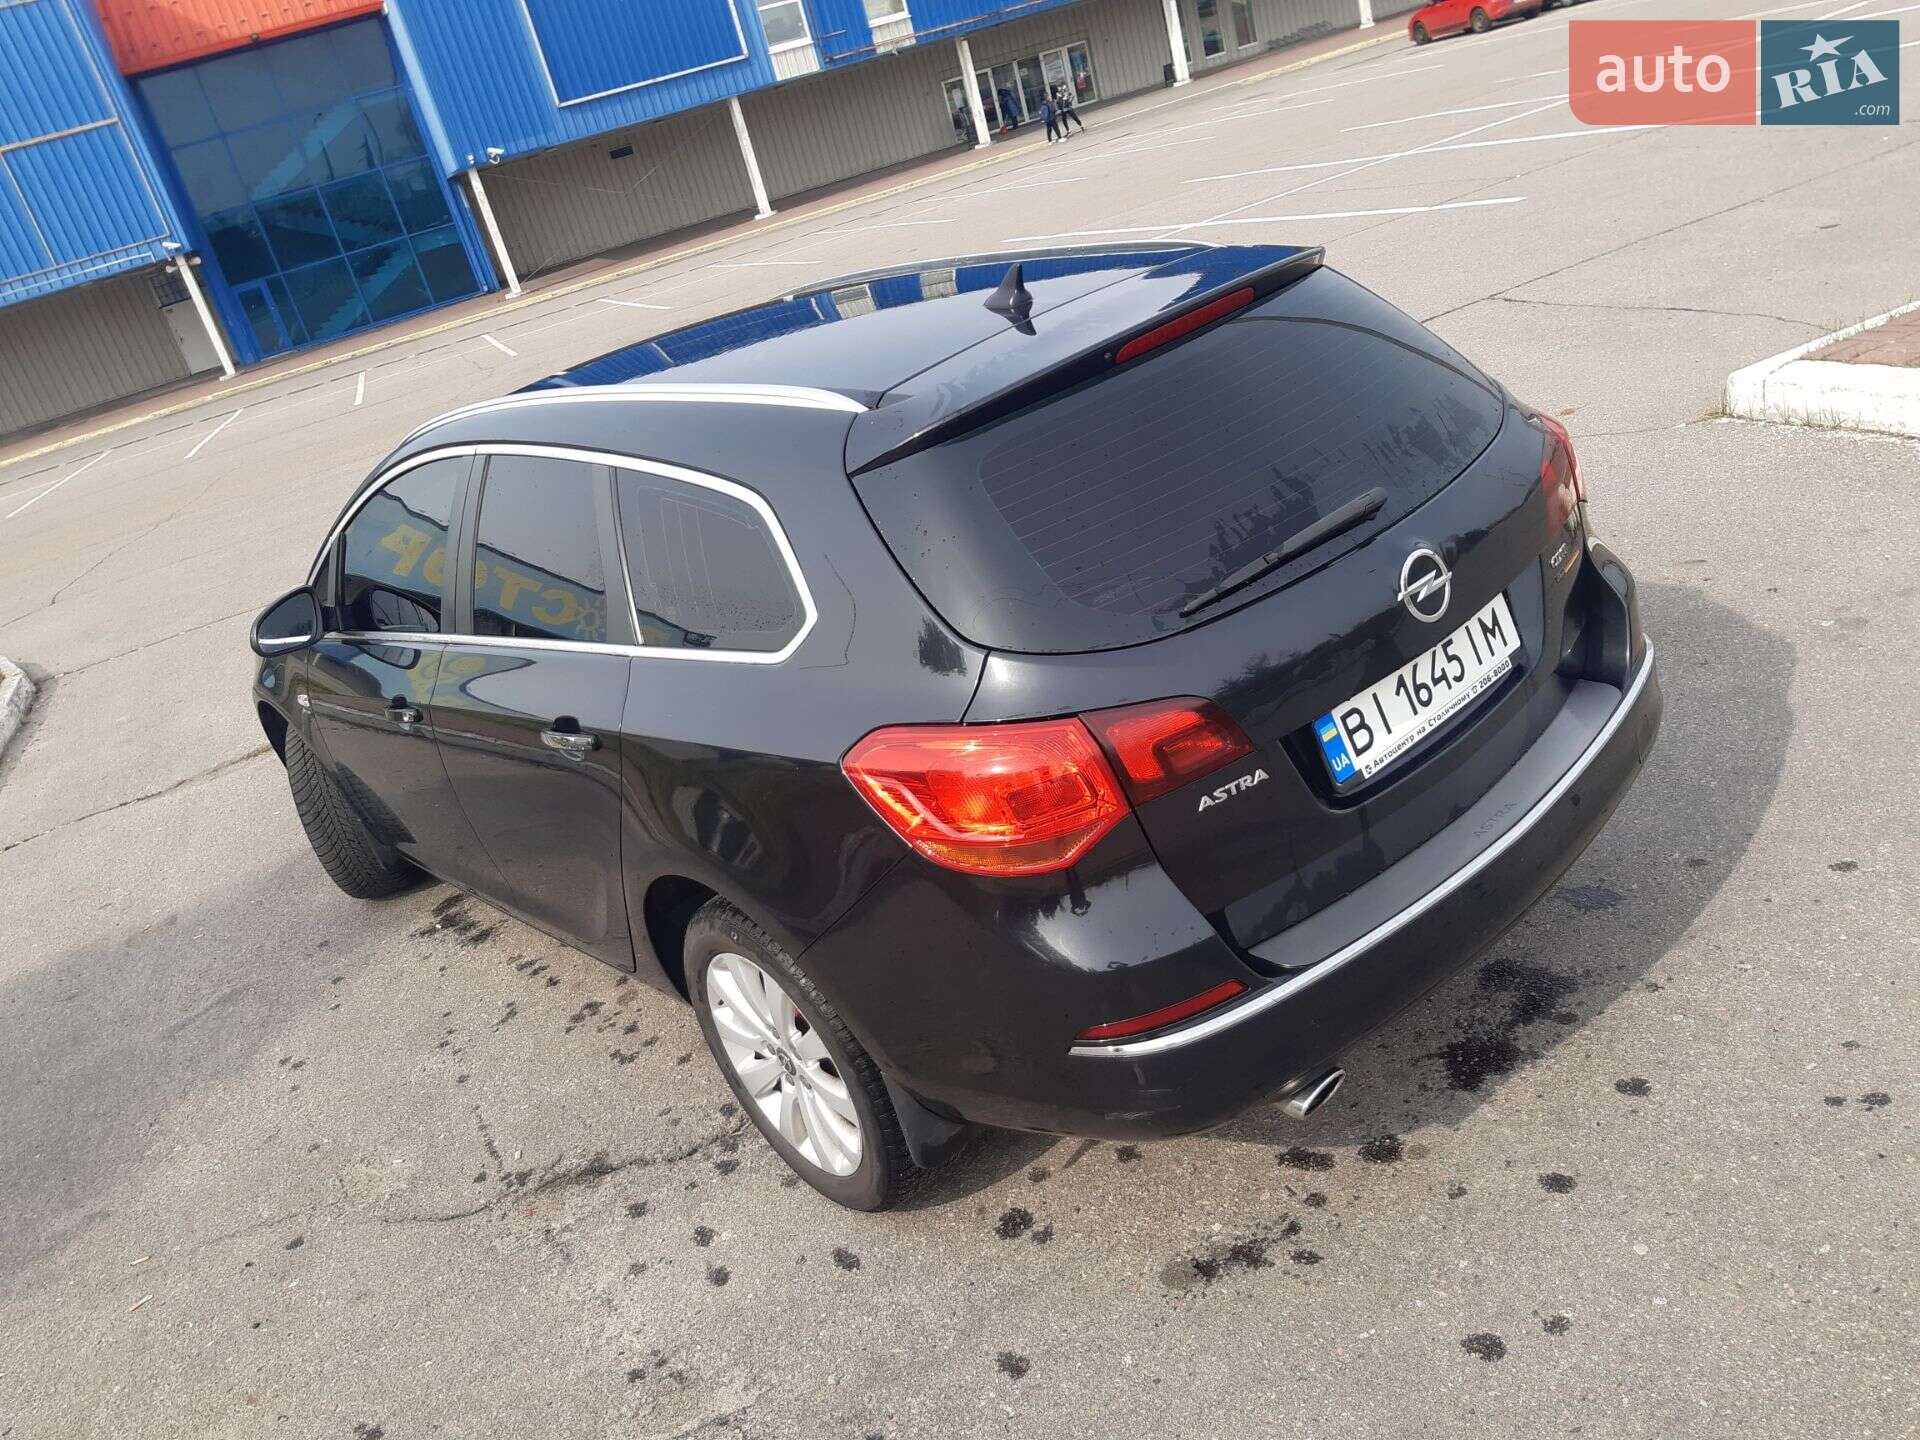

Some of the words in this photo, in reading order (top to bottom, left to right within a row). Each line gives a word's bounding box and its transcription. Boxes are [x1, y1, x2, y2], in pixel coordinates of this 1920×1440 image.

[1339, 692, 1392, 757] BI
[1395, 638, 1466, 716] 1645
[1465, 607, 1508, 666] IM
[1373, 734, 1415, 768] Автоцентр
[1416, 726, 1426, 736] на
[1428, 691, 1470, 727] Столичному
[1198, 768, 1270, 812] ASTRA
[1332, 757, 1350, 772] UA
